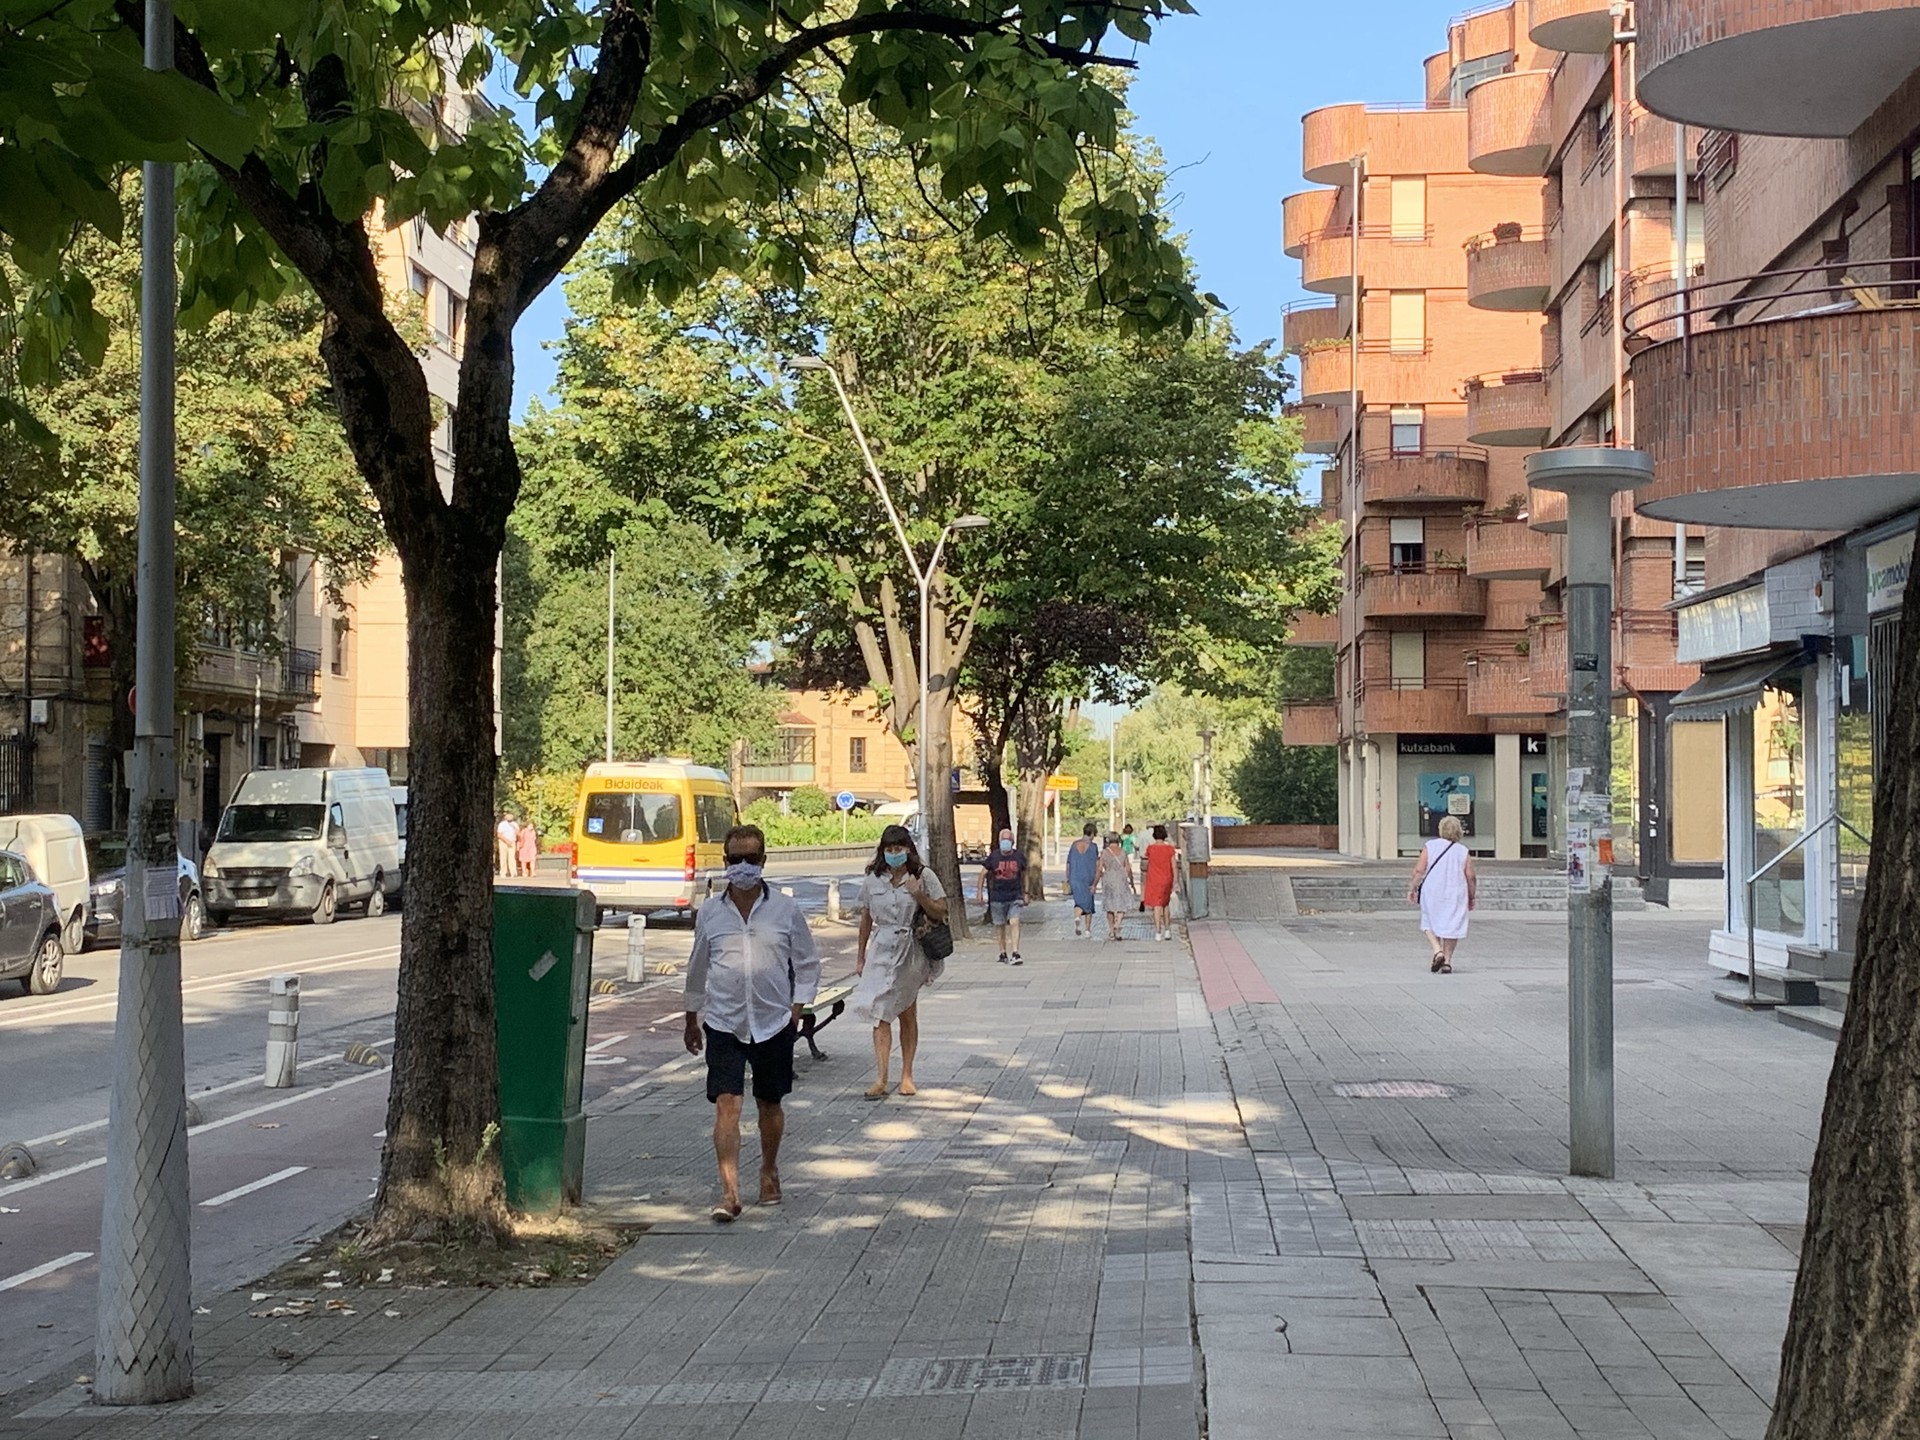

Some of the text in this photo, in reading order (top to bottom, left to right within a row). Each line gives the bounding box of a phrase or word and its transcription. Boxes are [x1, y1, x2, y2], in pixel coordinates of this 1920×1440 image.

[1400, 743, 1456, 753] kutxabank
[1527, 737, 1539, 753] k
[604, 779, 664, 790] Bidaideak
